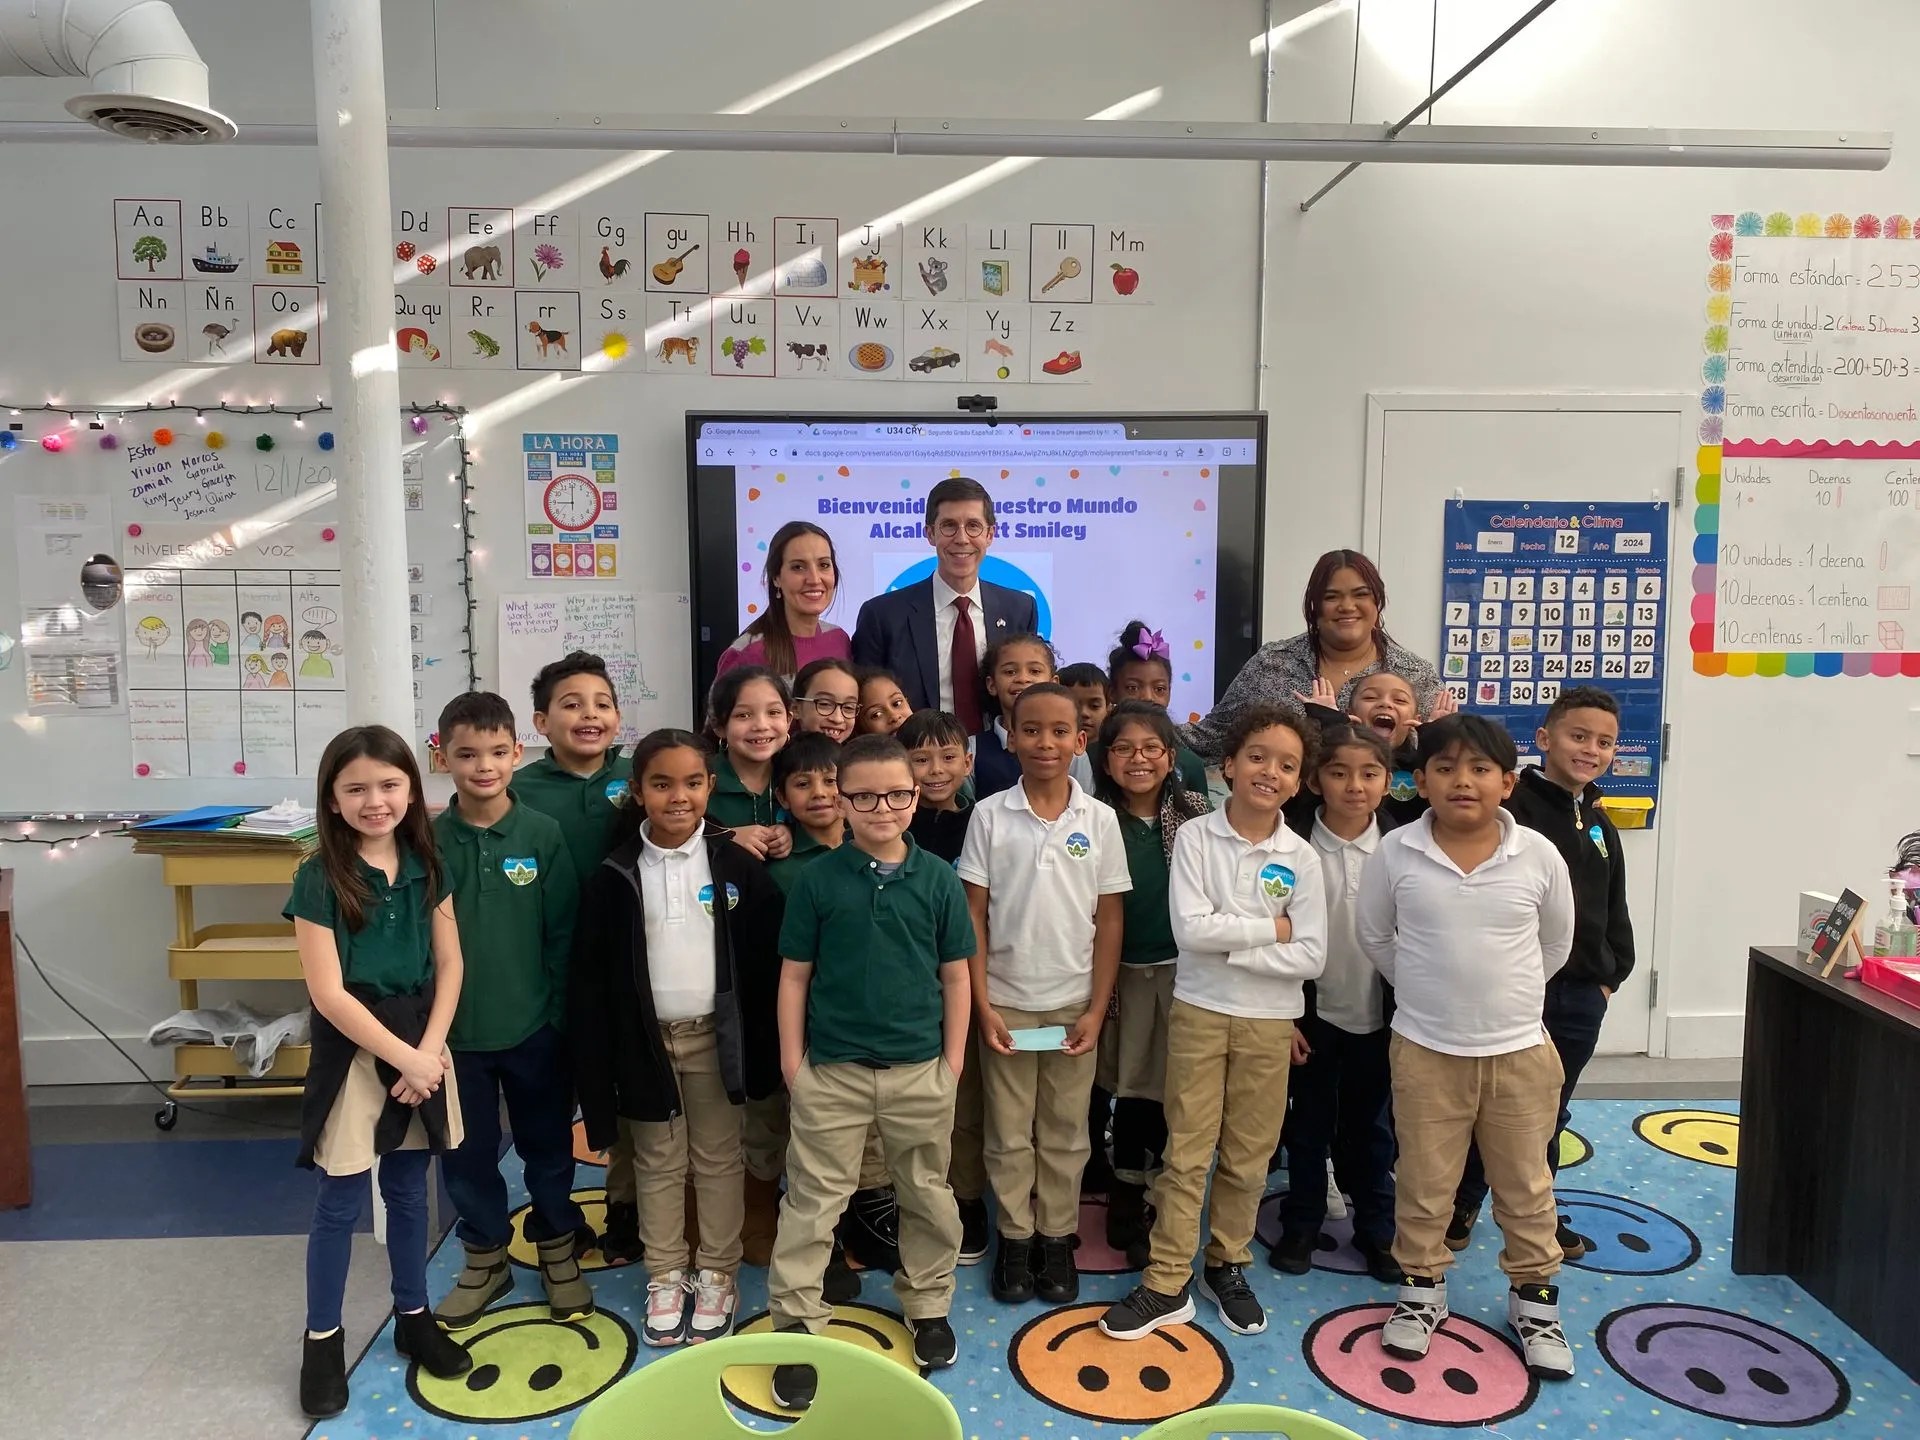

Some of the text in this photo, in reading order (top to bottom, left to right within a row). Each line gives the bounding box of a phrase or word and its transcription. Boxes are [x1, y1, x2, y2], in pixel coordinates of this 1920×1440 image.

[1735, 255, 1780, 284] Forma
[1789, 257, 1854, 287] estándar
[1730, 302, 1767, 330] Forma
[1771, 304, 1783, 329] de
[1787, 305, 1818, 331] unidad
[1728, 348, 1766, 372] Forma
[1725, 394, 1816, 418] Forma escrita
[887, 426, 922, 435] U34 CRY
[533, 436, 606, 450] LA HORA
[1724, 466, 1771, 484] Unidades
[1809, 469, 1851, 484] Decenas
[817, 496, 1138, 514] Bienvenid uestro Mundo
[1489, 515, 1569, 528] Calendario
[1581, 515, 1624, 528] Clima
[869, 521, 1087, 540] Alcal Smiley
[212, 544, 233, 556] DE
[257, 545, 297, 557] VOZ
[1455, 542, 1472, 551] Mes
[1520, 542, 1546, 551] Fecha
[1559, 535, 1575, 549] 12
[1593, 541, 1610, 551] Año
[1622, 539, 1644, 547] 2024
[1720, 543, 1740, 566] 10
[1743, 544, 1792, 567] unidades
[1819, 544, 1865, 568] decena
[1484, 567, 1503, 575] Lunes
[1492, 582, 1653, 595] 1 2 3 4 5 6
[1720, 579, 1740, 605] 10
[1740, 579, 1795, 606] decenas
[1818, 583, 1869, 607] centena
[299, 591, 320, 602] Alto
[1453, 608, 1653, 620] 7 8 9 10 11 13
[1719, 620, 1739, 644] 10
[1741, 618, 1803, 645] centenas
[1830, 621, 1870, 645] millar
[1452, 634, 1653, 647] 14 17 18 19 20
[1483, 660, 1651, 673] 22 23 24 25 26 27
[1512, 687, 1532, 699] 30
[1541, 687, 1557, 699] 31
